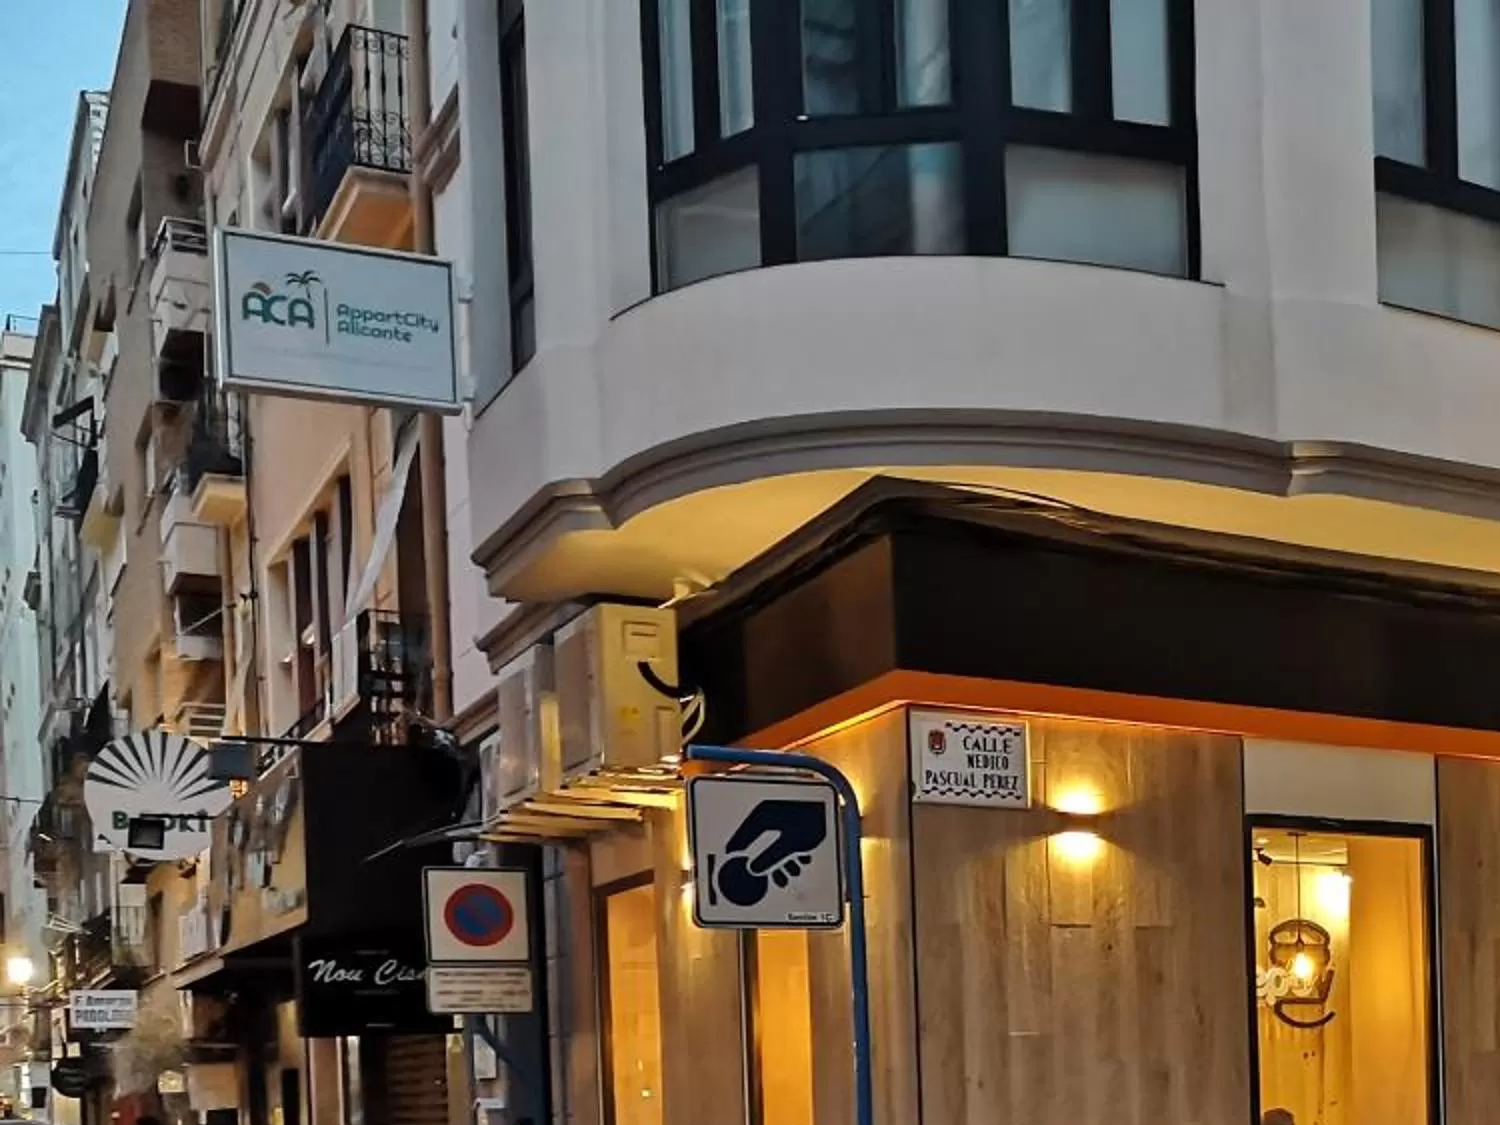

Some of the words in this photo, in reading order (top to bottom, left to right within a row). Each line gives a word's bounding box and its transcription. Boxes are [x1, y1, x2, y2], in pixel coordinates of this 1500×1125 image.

[242, 291, 315, 330] ACA
[337, 320, 413, 343] Alicante
[963, 736, 1013, 754] CALLE
[925, 769, 977, 789] PASCUAL
[307, 959, 364, 983] Nou
